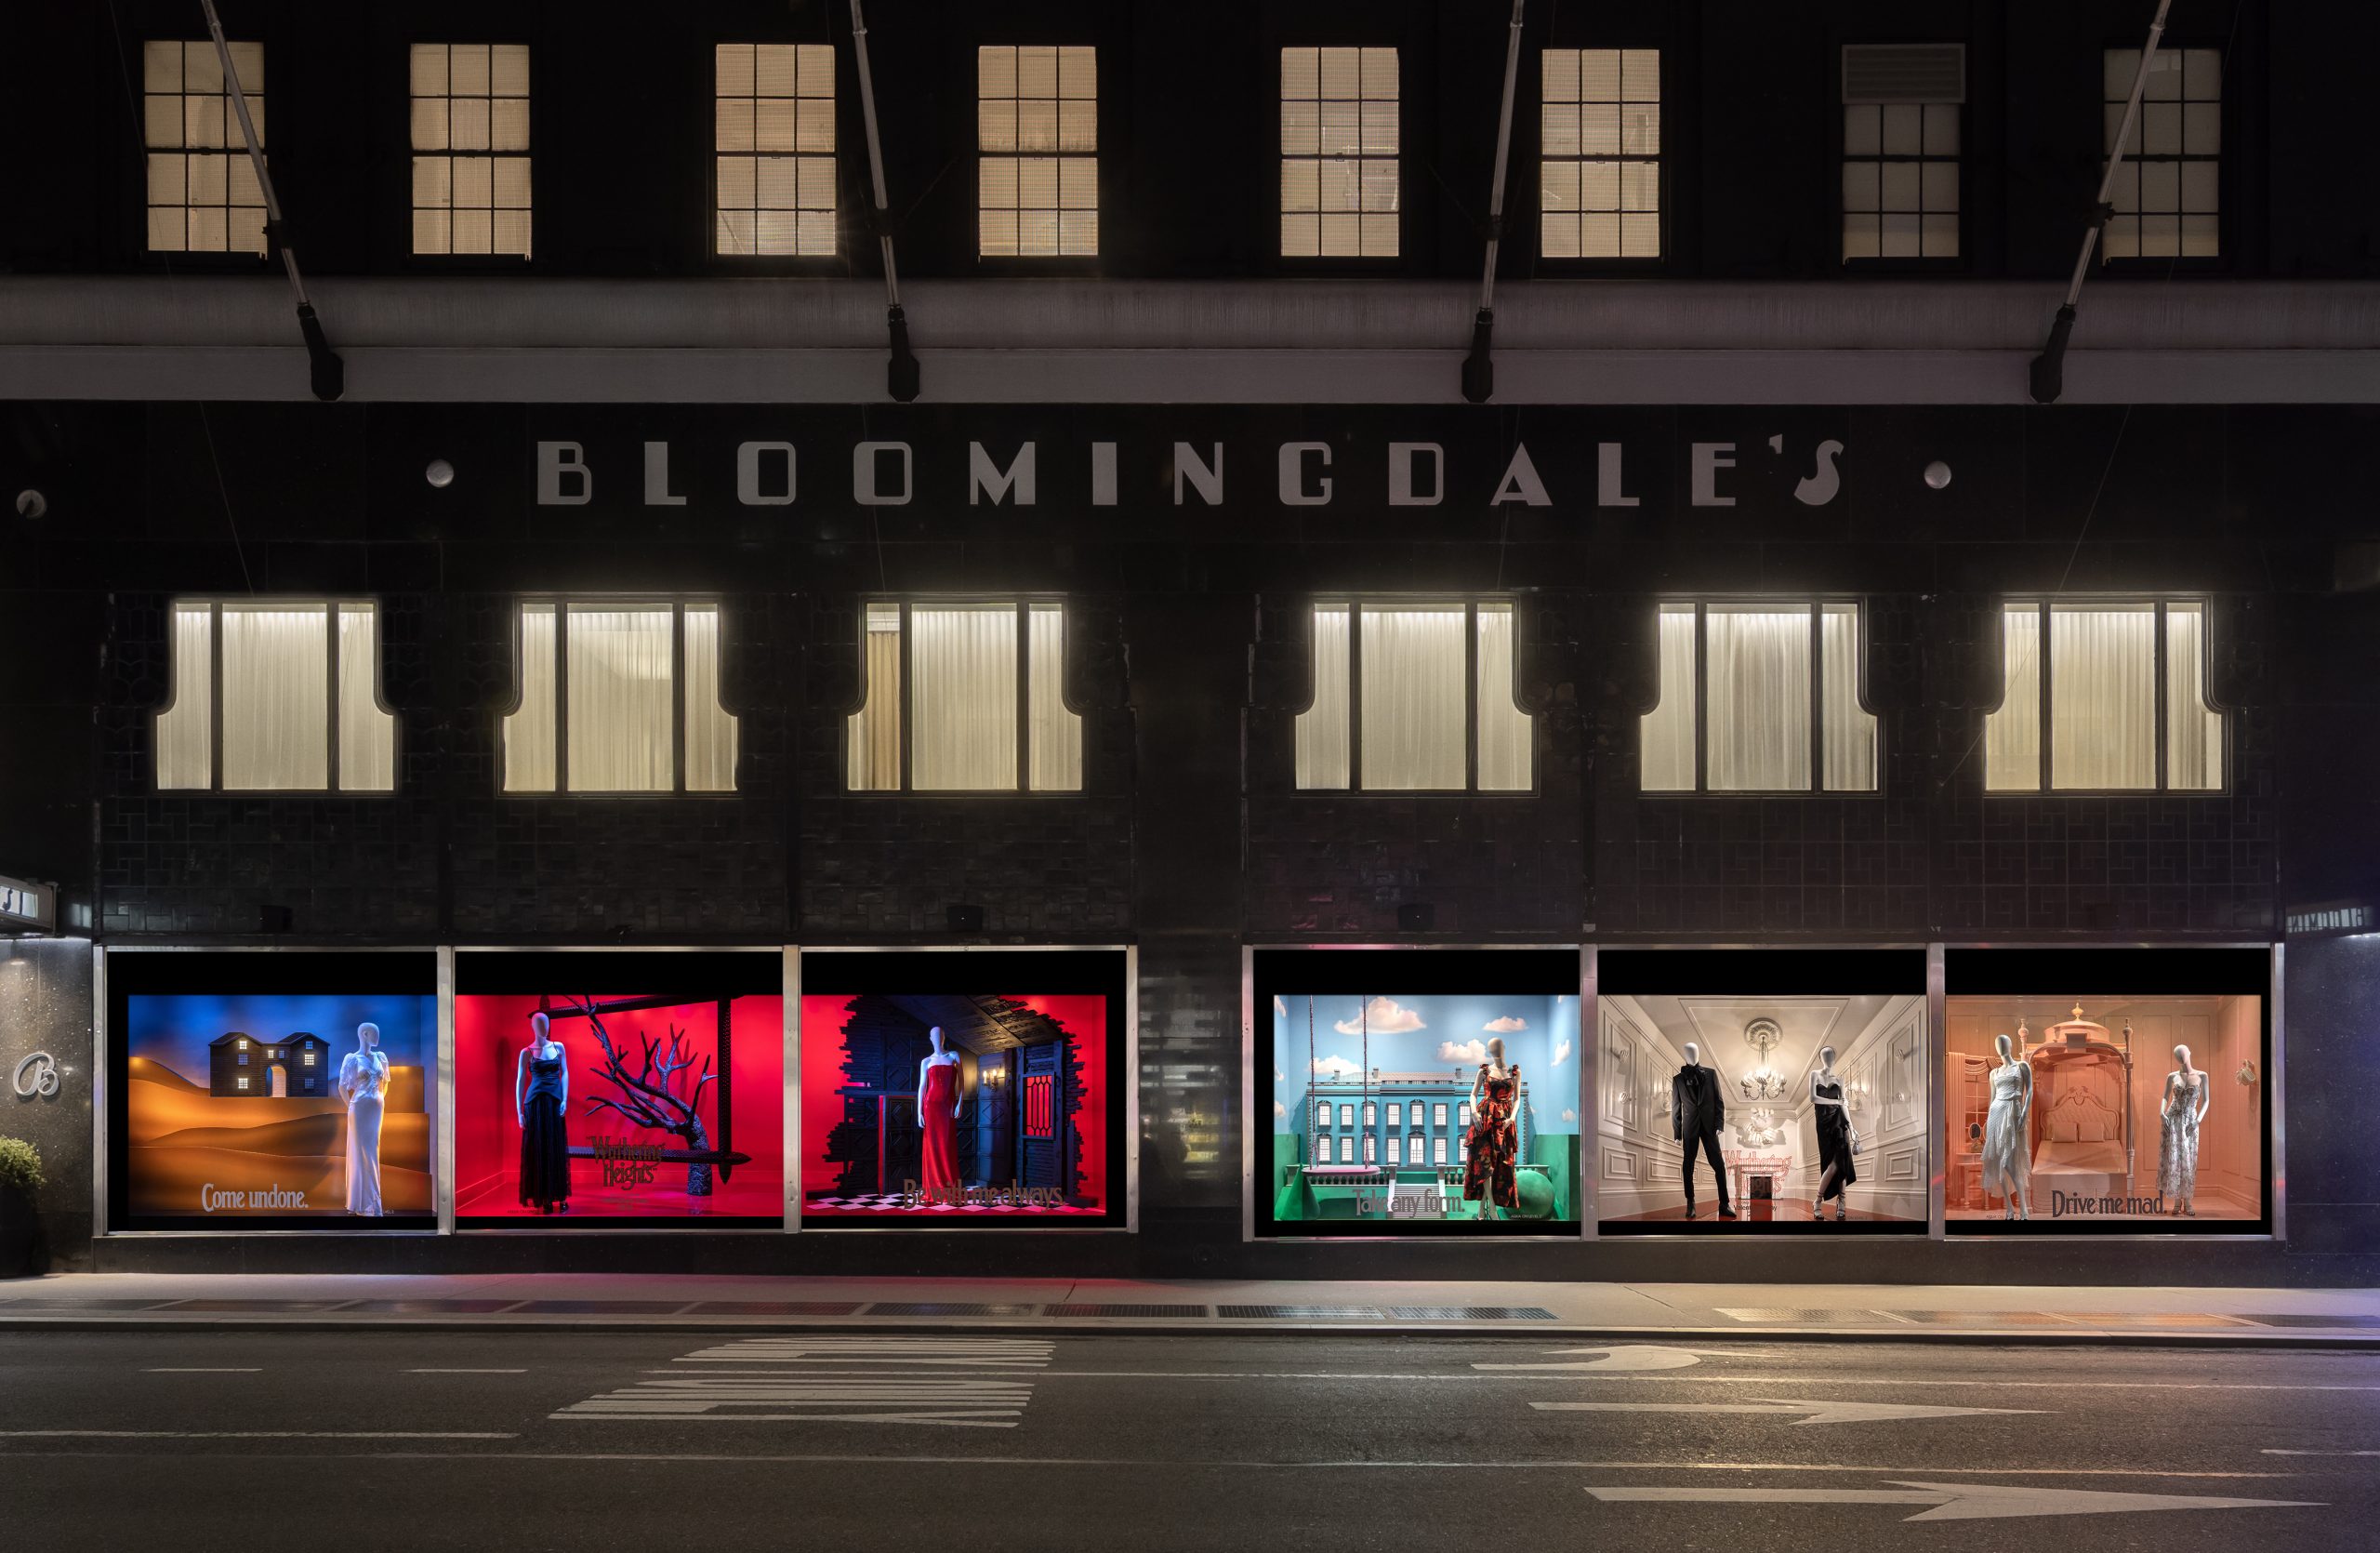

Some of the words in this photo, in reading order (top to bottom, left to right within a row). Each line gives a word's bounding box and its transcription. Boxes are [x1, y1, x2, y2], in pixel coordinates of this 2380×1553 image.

[536, 432, 1845, 507] BLOOMINGDALE'S
[202, 1183, 245, 1213] Come
[248, 1183, 310, 1208] undone.
[904, 1178, 927, 1209] Be
[932, 1179, 968, 1206] with
[972, 1187, 998, 1206] me
[1353, 1189, 1389, 1216] Take
[1391, 1196, 1419, 1218] any
[1424, 1188, 1465, 1212] form.
[2052, 1189, 2096, 1217] Drive
[2098, 1198, 2123, 1215] me
[2126, 1189, 2167, 1215] mad.
[671, 1336, 1057, 1367] ONLY
[548, 1379, 1036, 1428] ONLY
